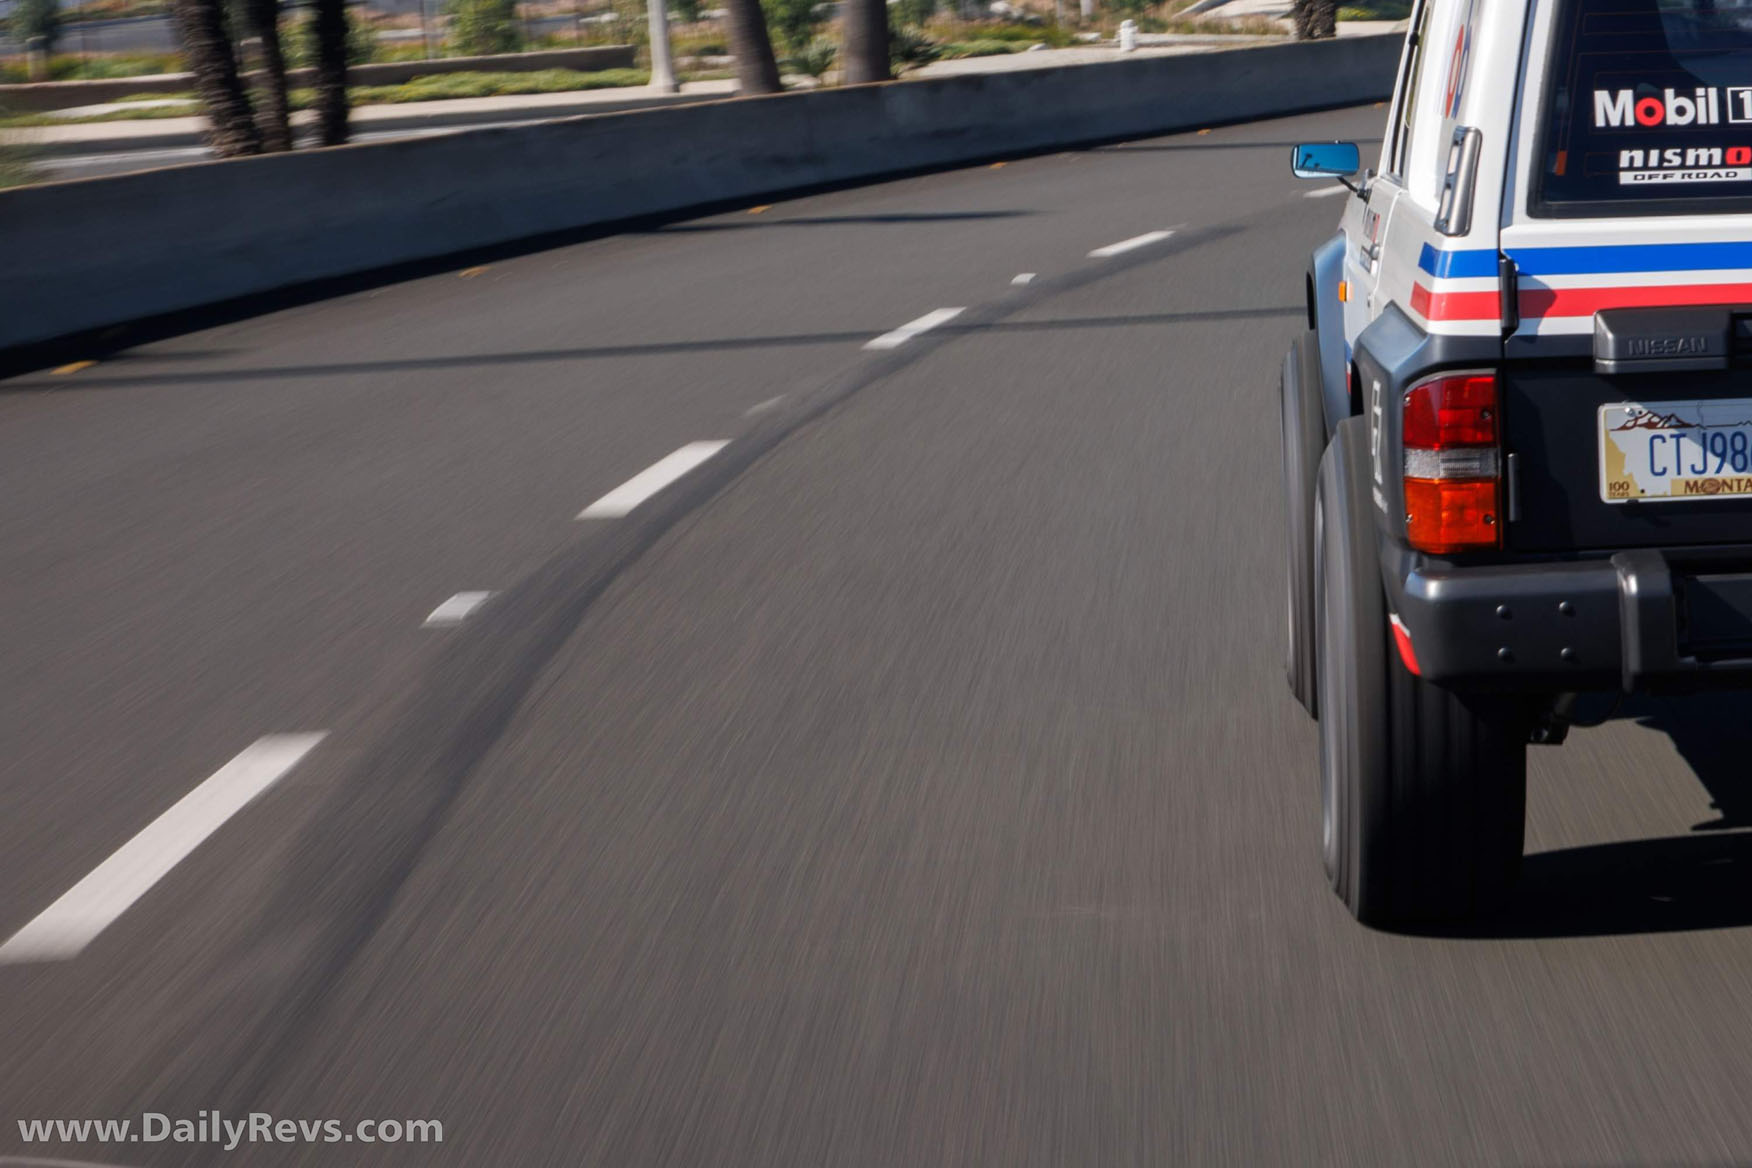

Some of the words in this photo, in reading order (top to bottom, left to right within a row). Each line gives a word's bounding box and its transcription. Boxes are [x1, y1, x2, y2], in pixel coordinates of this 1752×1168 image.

[1594, 87, 1719, 127] Mobil
[1619, 146, 1752, 168] nismo
[1633, 172, 1675, 181] OFF
[1681, 170, 1738, 180] ROAD
[1627, 336, 1707, 357] NISSAN
[1609, 481, 1630, 491] 100
